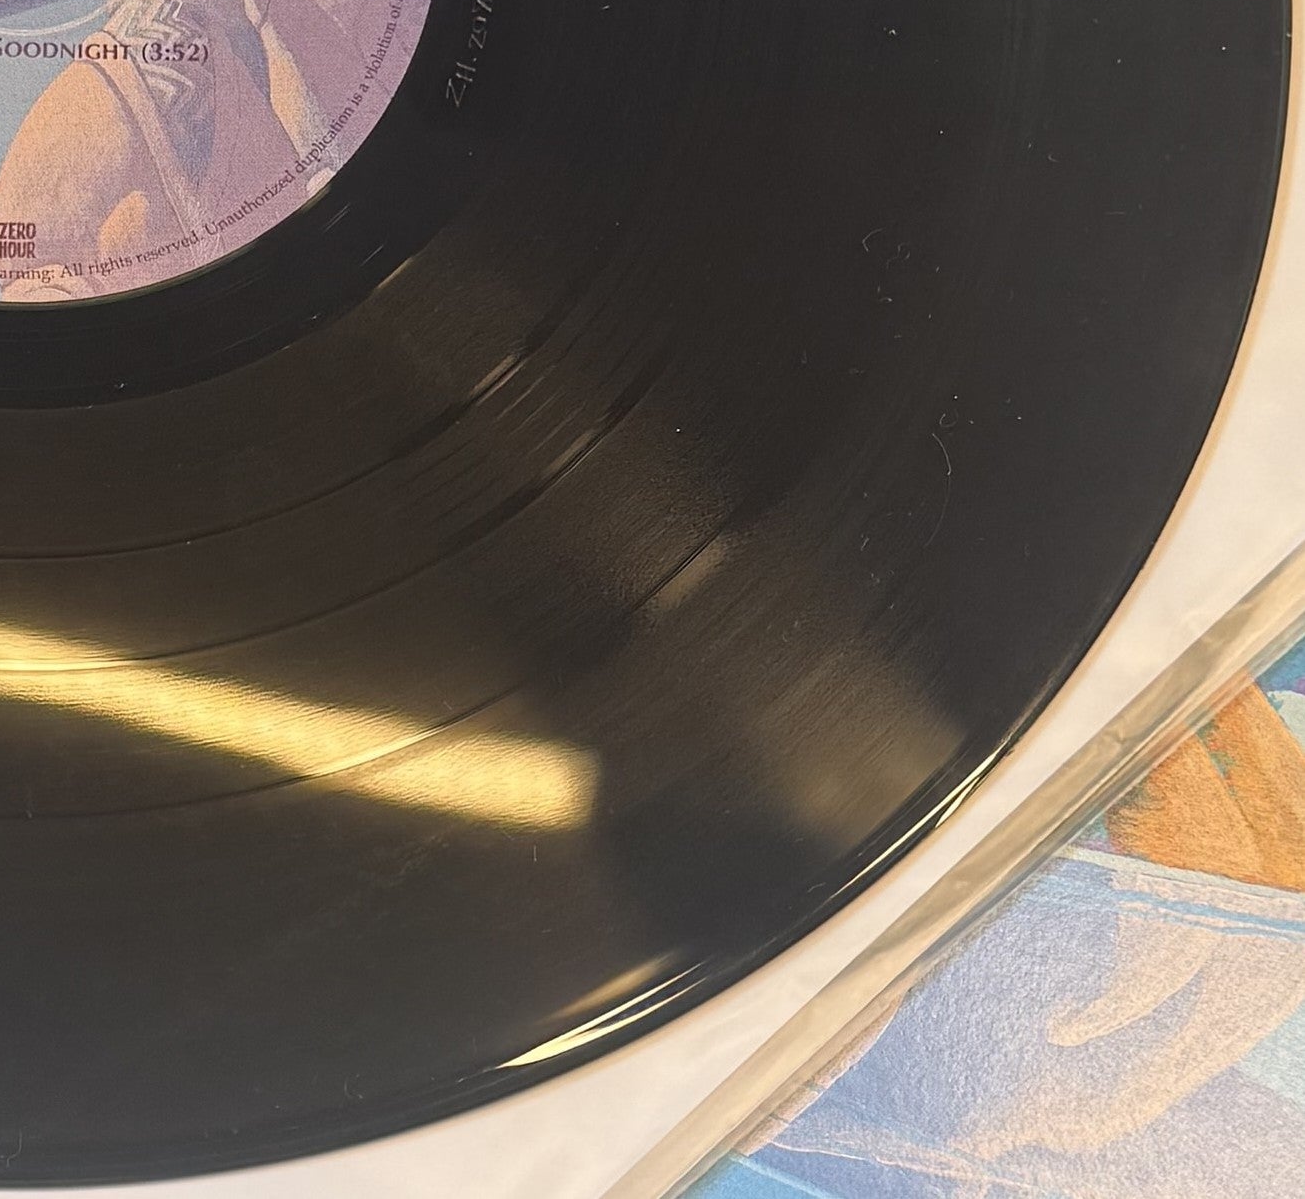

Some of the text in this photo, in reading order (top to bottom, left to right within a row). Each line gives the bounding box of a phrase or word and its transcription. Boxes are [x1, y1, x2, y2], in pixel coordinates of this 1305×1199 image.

[141, 42, 209, 63] (3:52)
[60, 262, 82, 278] All
[88, 255, 133, 277] rights
[136, 228, 204, 264] reserved.
[205, 169, 295, 235] Unauthorized
[295, 106, 355, 174] duplication
[351, 93, 364, 106] is
[359, 83, 369, 93] a
[364, 22, 397, 81] violation
[390, 3, 403, 19] of
